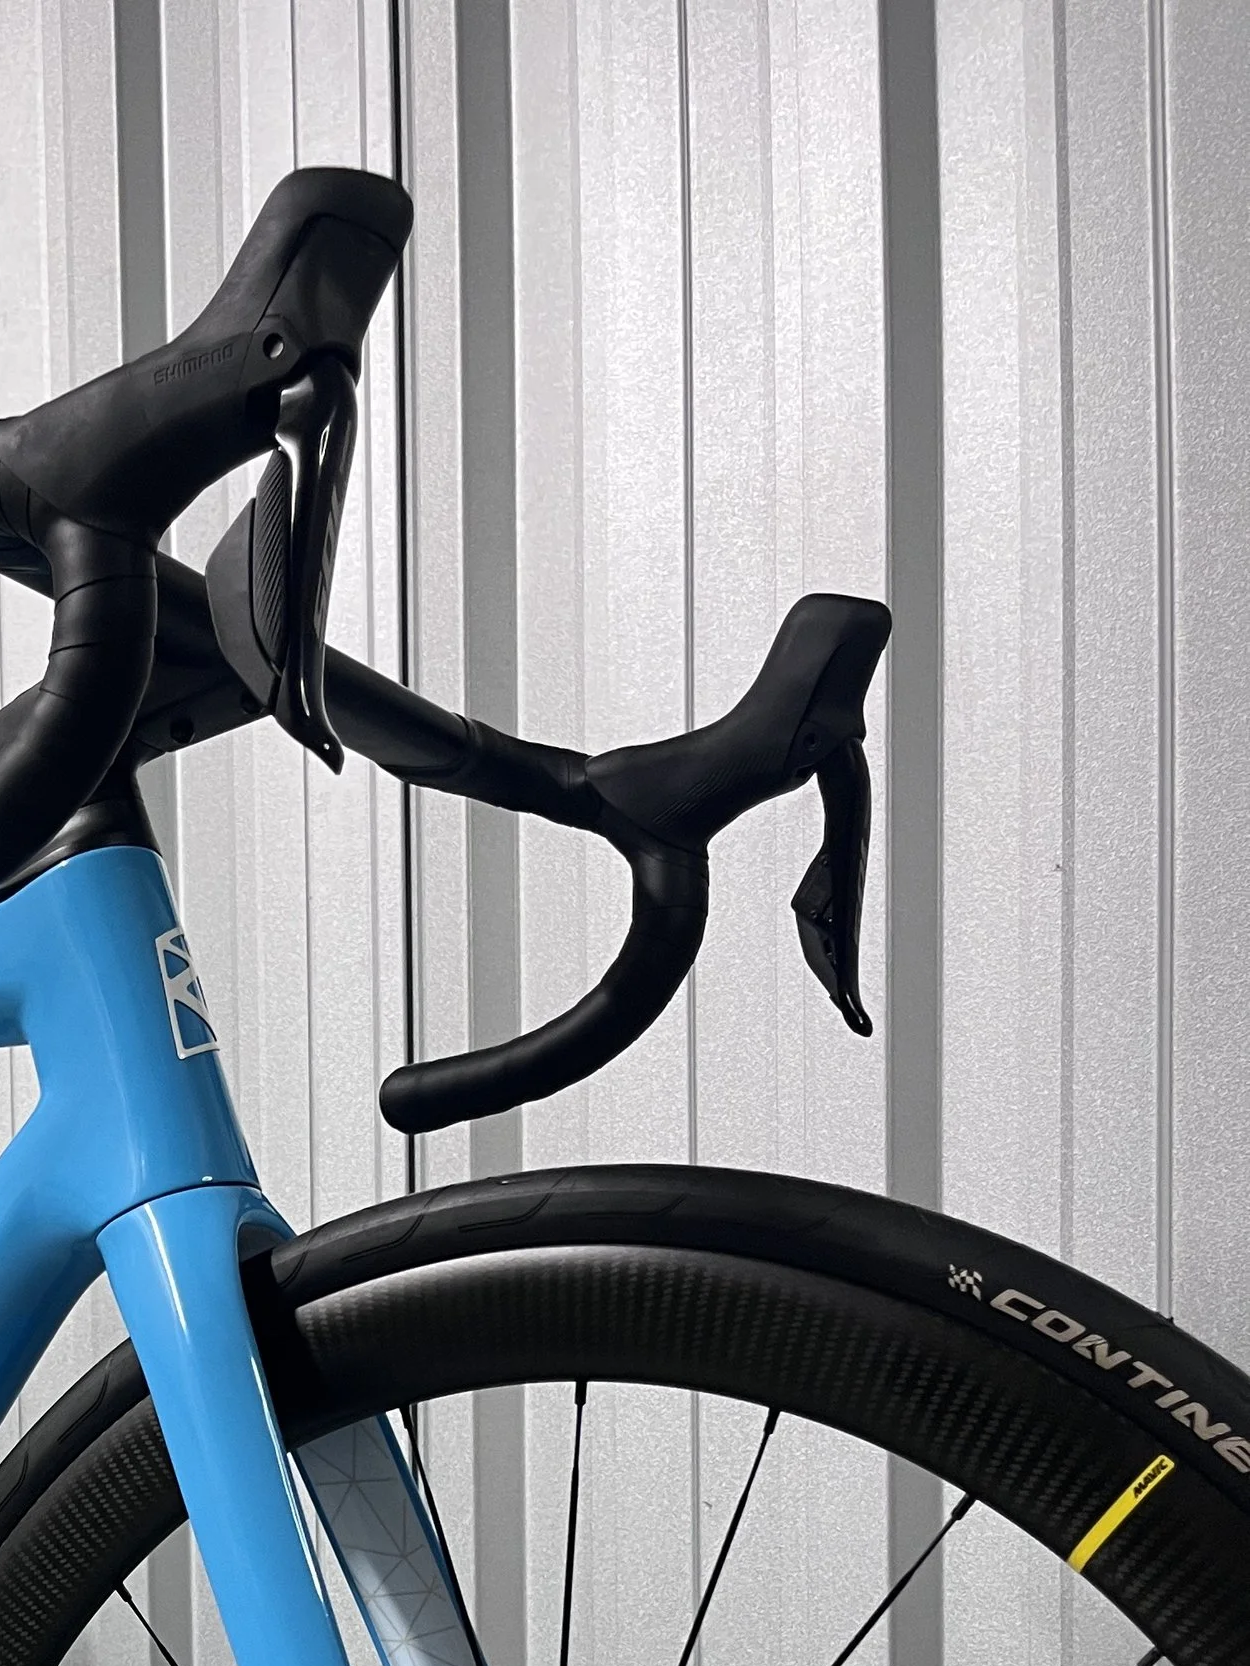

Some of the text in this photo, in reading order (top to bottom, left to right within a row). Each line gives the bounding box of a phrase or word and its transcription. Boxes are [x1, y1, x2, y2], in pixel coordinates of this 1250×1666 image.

[153, 343, 234, 386] SHIMANO
[989, 1288, 1250, 1474] CONTINE
[1133, 1458, 1169, 1499] MAVIC
